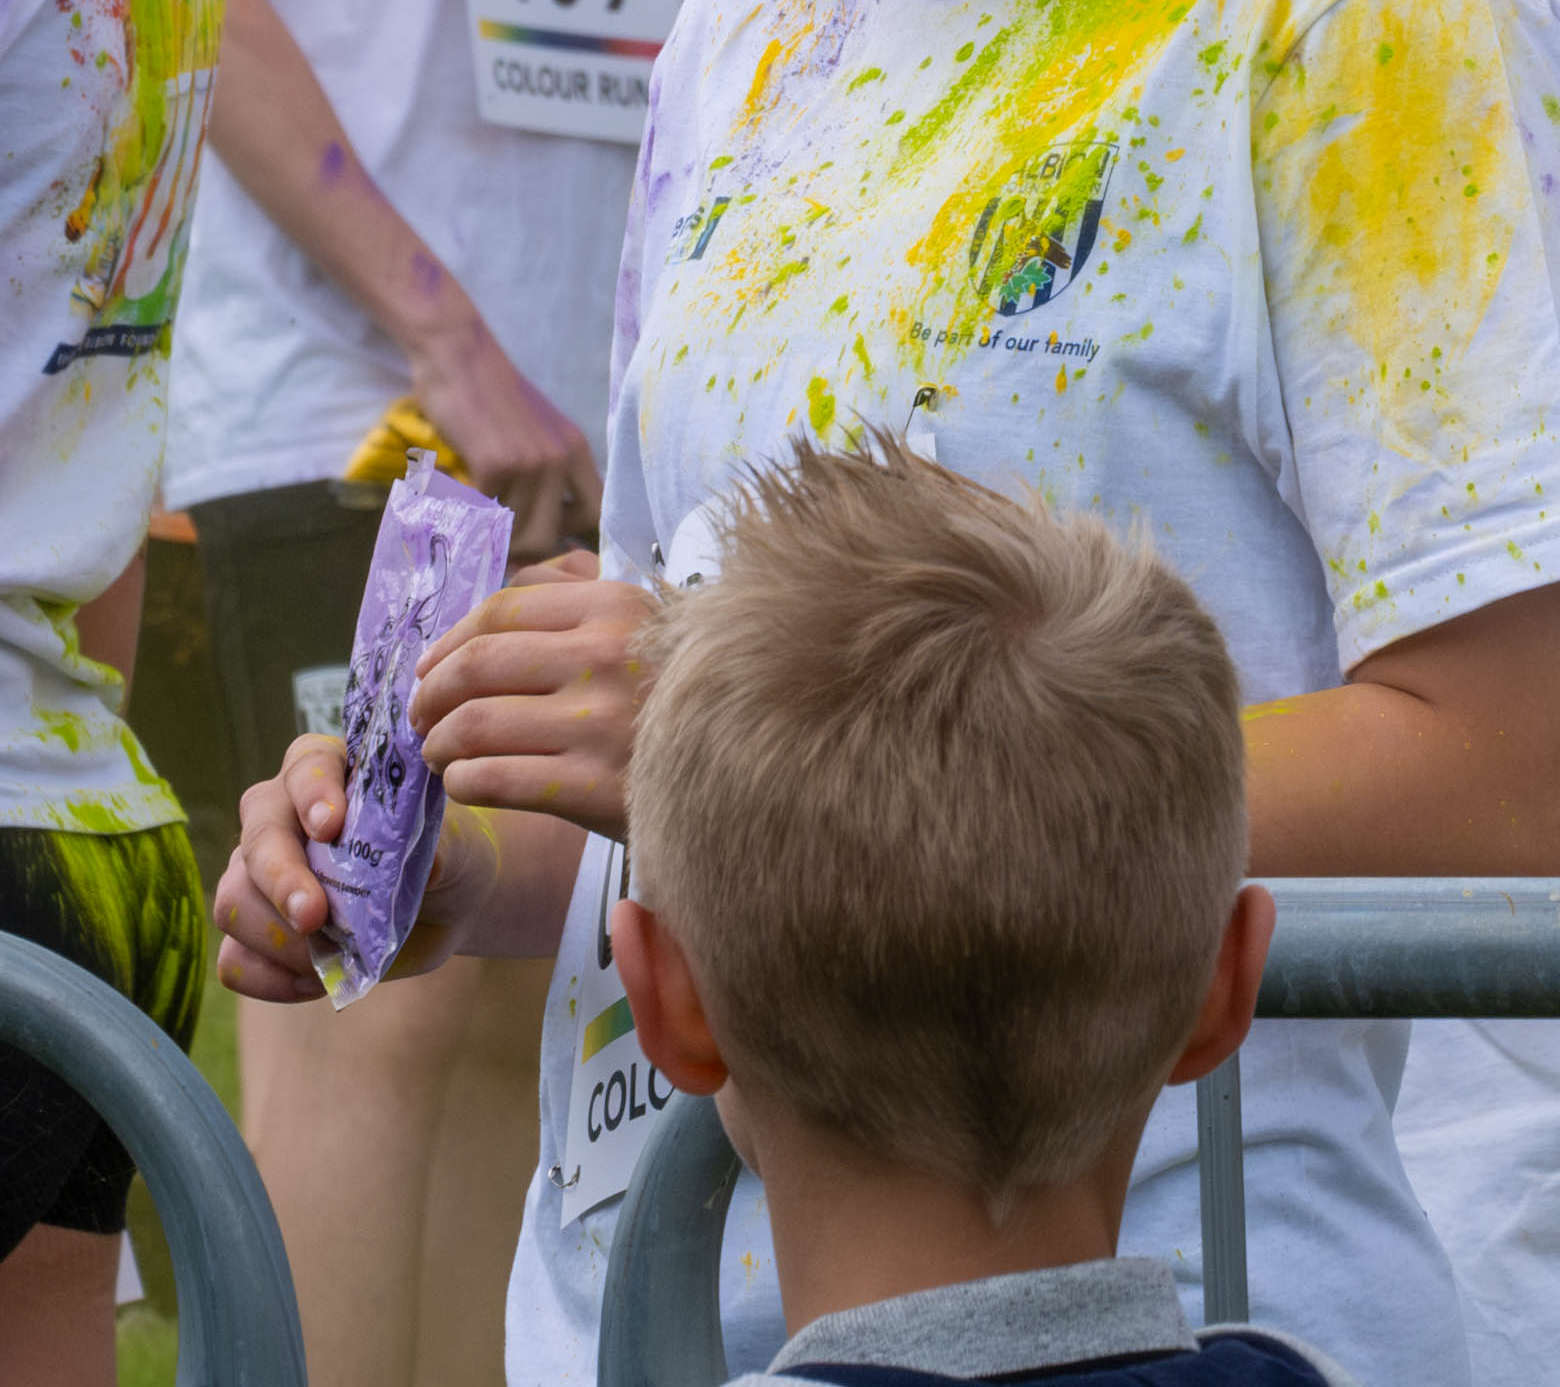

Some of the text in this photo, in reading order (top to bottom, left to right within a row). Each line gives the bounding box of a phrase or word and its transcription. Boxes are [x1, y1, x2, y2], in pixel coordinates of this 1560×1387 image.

[493, 57, 590, 103] COLOUR
[1004, 337, 1040, 353] our
[1044, 334, 1102, 363] family
